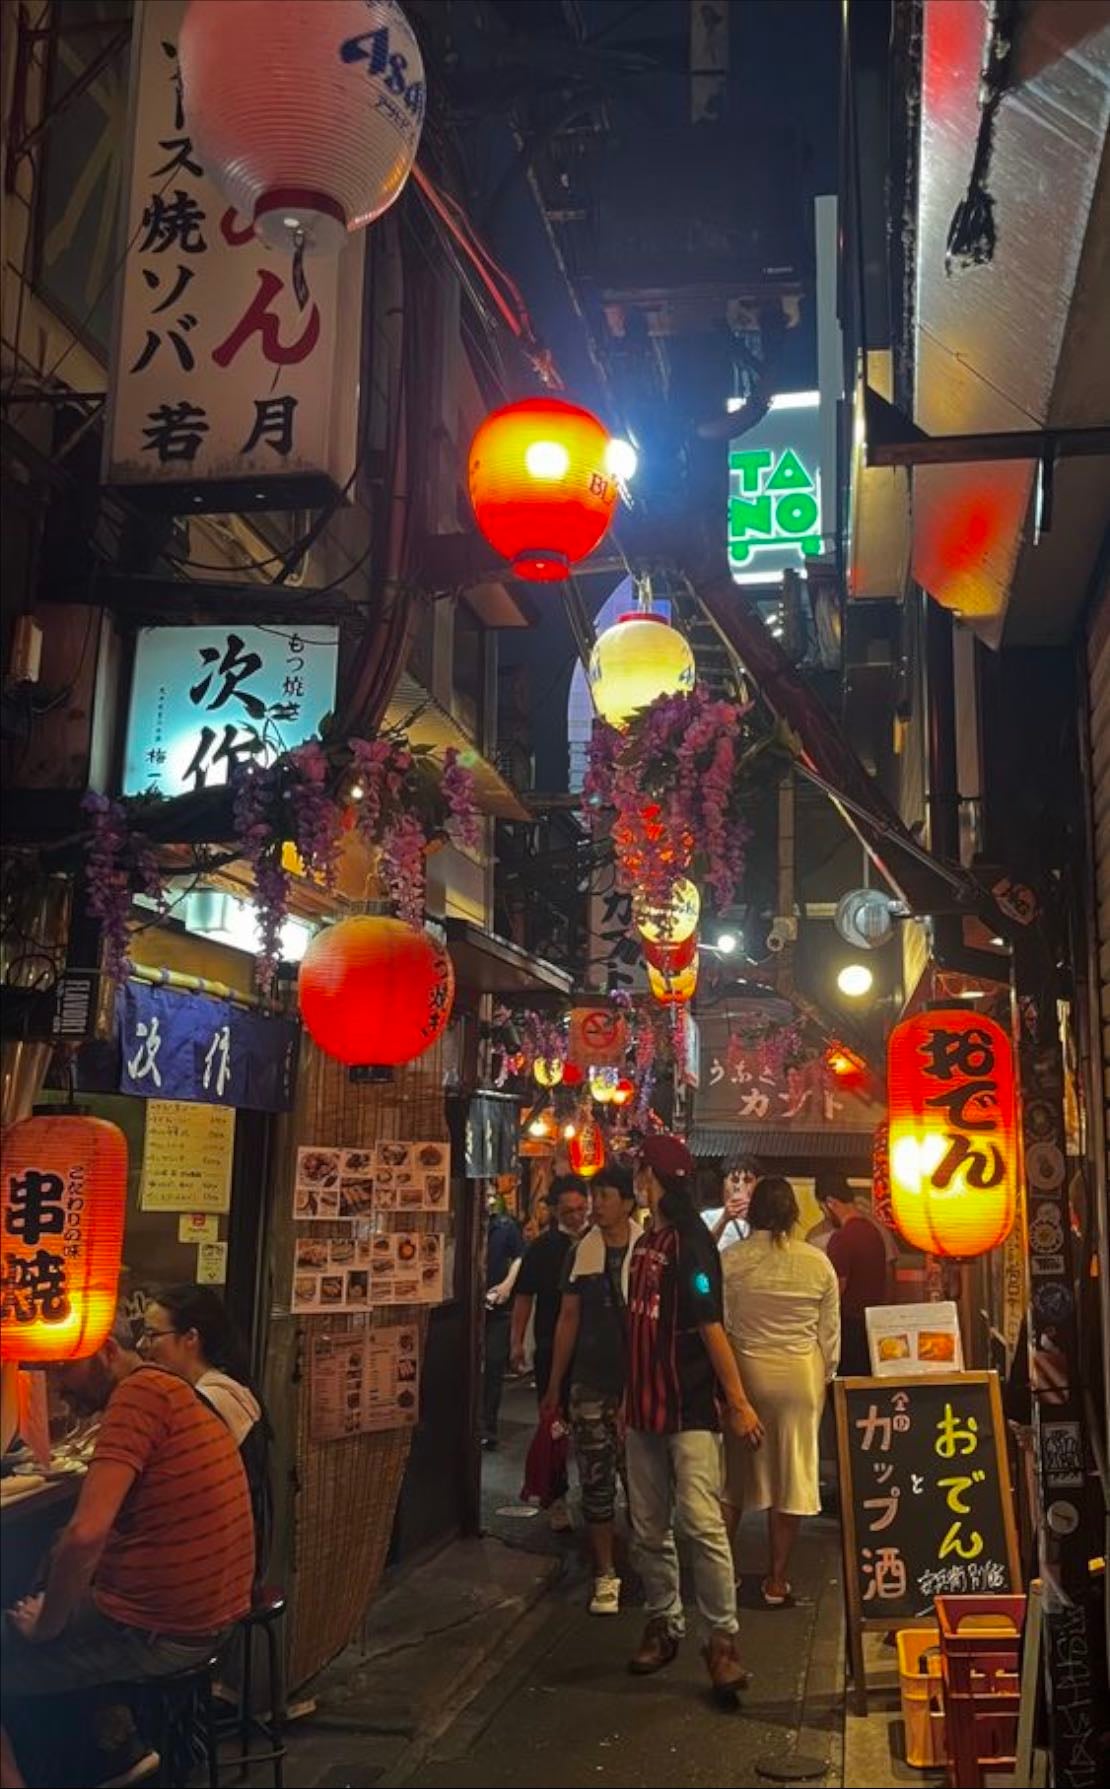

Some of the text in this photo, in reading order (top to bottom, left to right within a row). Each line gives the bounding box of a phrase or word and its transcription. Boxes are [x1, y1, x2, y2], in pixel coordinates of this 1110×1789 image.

[917, 1029, 1005, 1189] おでん
[0, 1170, 71, 1322] 串焼
[910, 1473, 925, 1495] と
[934, 1403, 986, 1560] おでん
